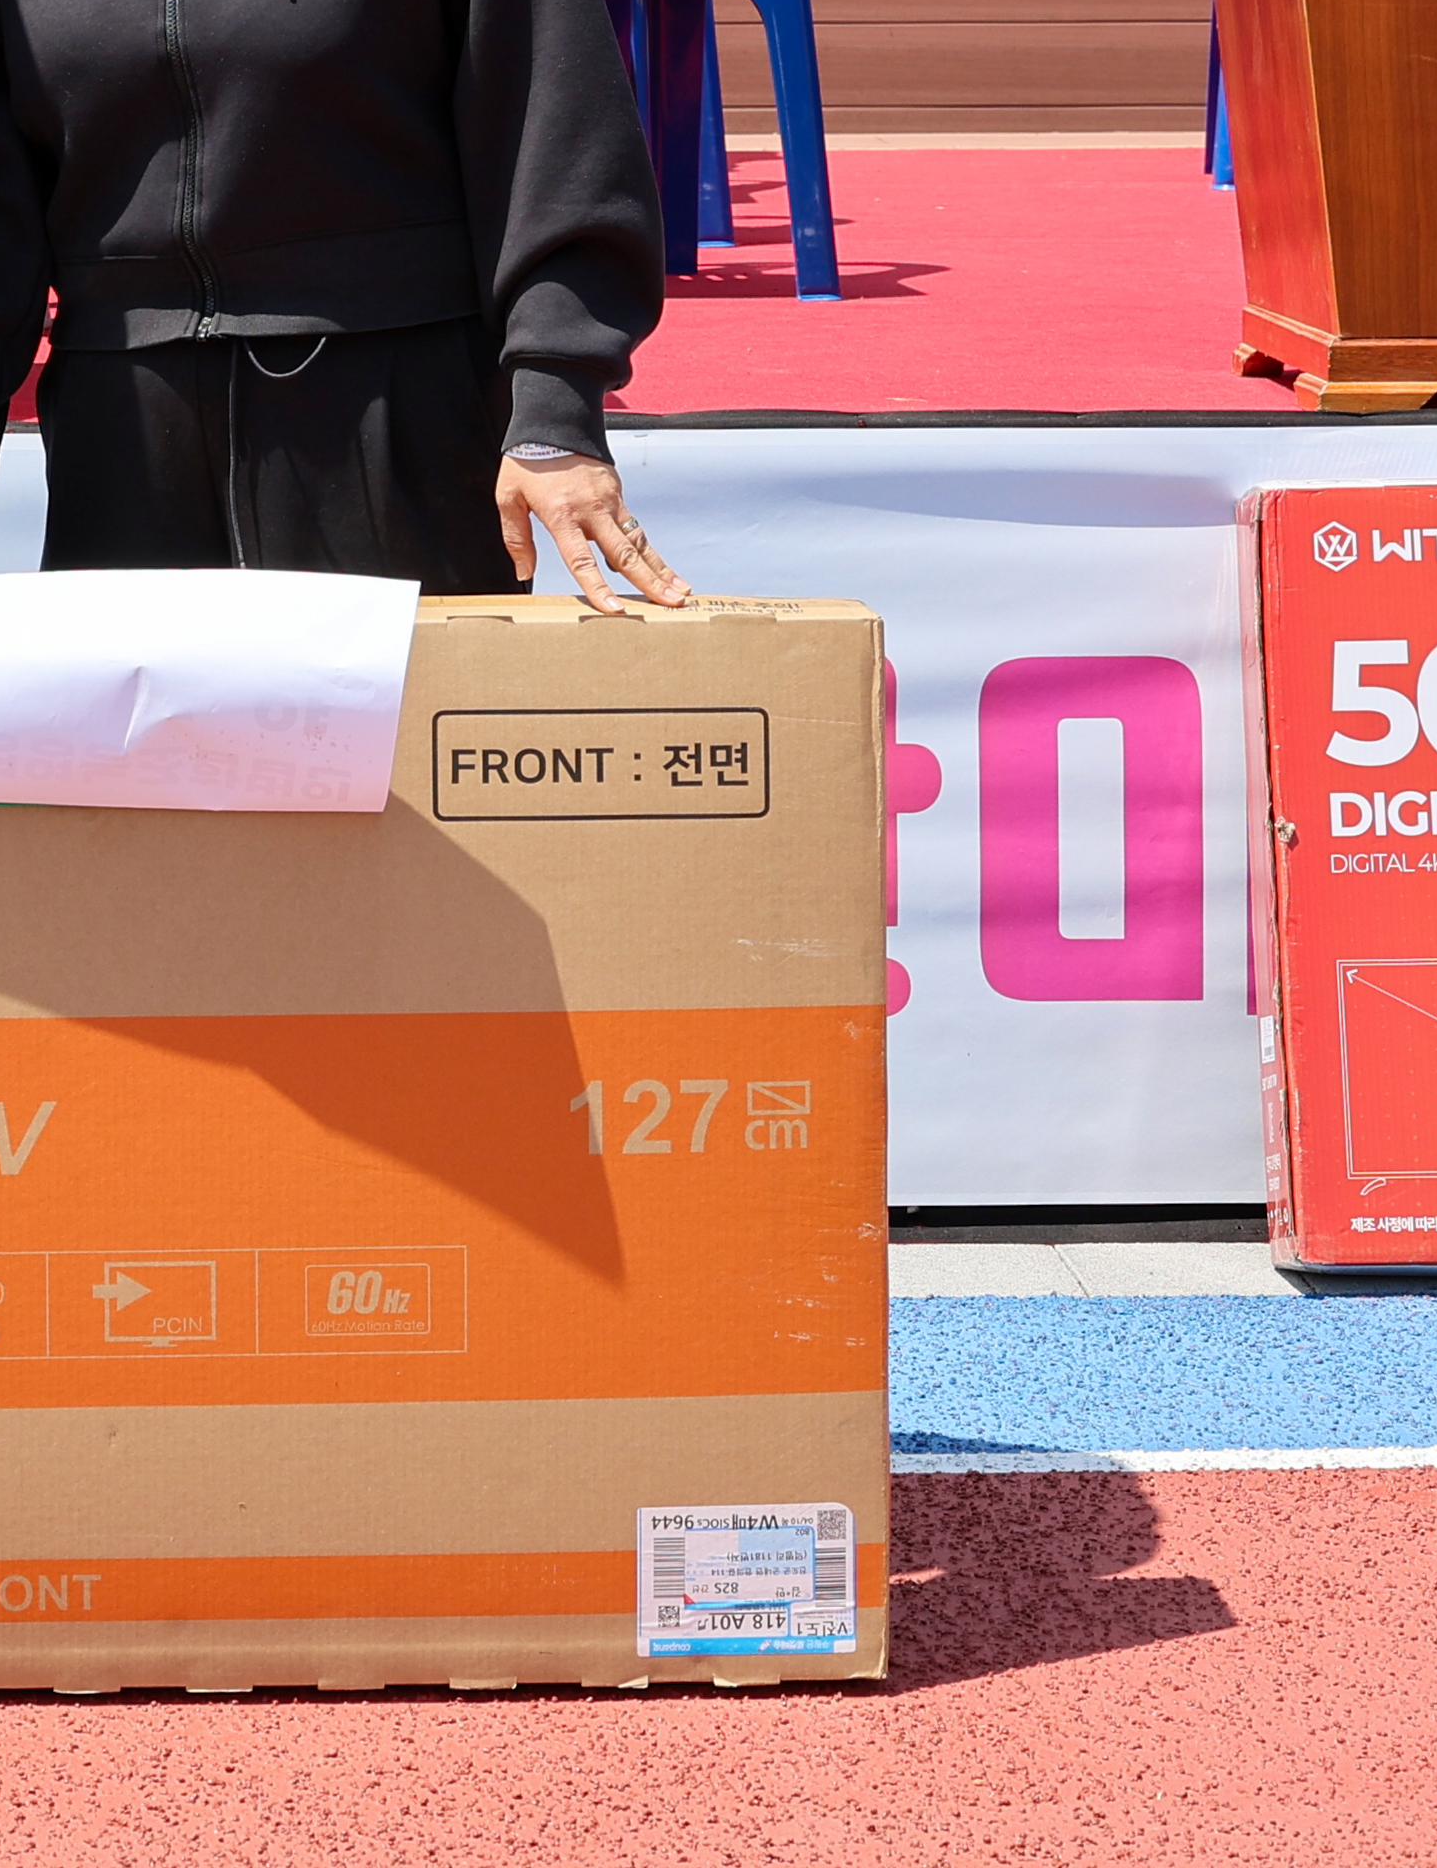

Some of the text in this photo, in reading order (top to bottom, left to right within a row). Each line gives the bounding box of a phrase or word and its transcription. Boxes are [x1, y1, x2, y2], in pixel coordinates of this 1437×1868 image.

[452, 748, 613, 784] FRONT
[663, 742, 748, 786] 전면
[1331, 853, 1415, 873] DIGITAL
[570, 1079, 729, 1155] 127
[745, 1119, 807, 1150] cm
[1350, 1217, 1375, 1233] 제조
[1377, 1216, 1413, 1232] 사정에
[152, 1316, 203, 1334] PCIN
[345, 1320, 390, 1332] Motion
[394, 1319, 425, 1331] Rate
[651, 1514, 694, 1530] 9644
[753, 1614, 787, 1630] 418
